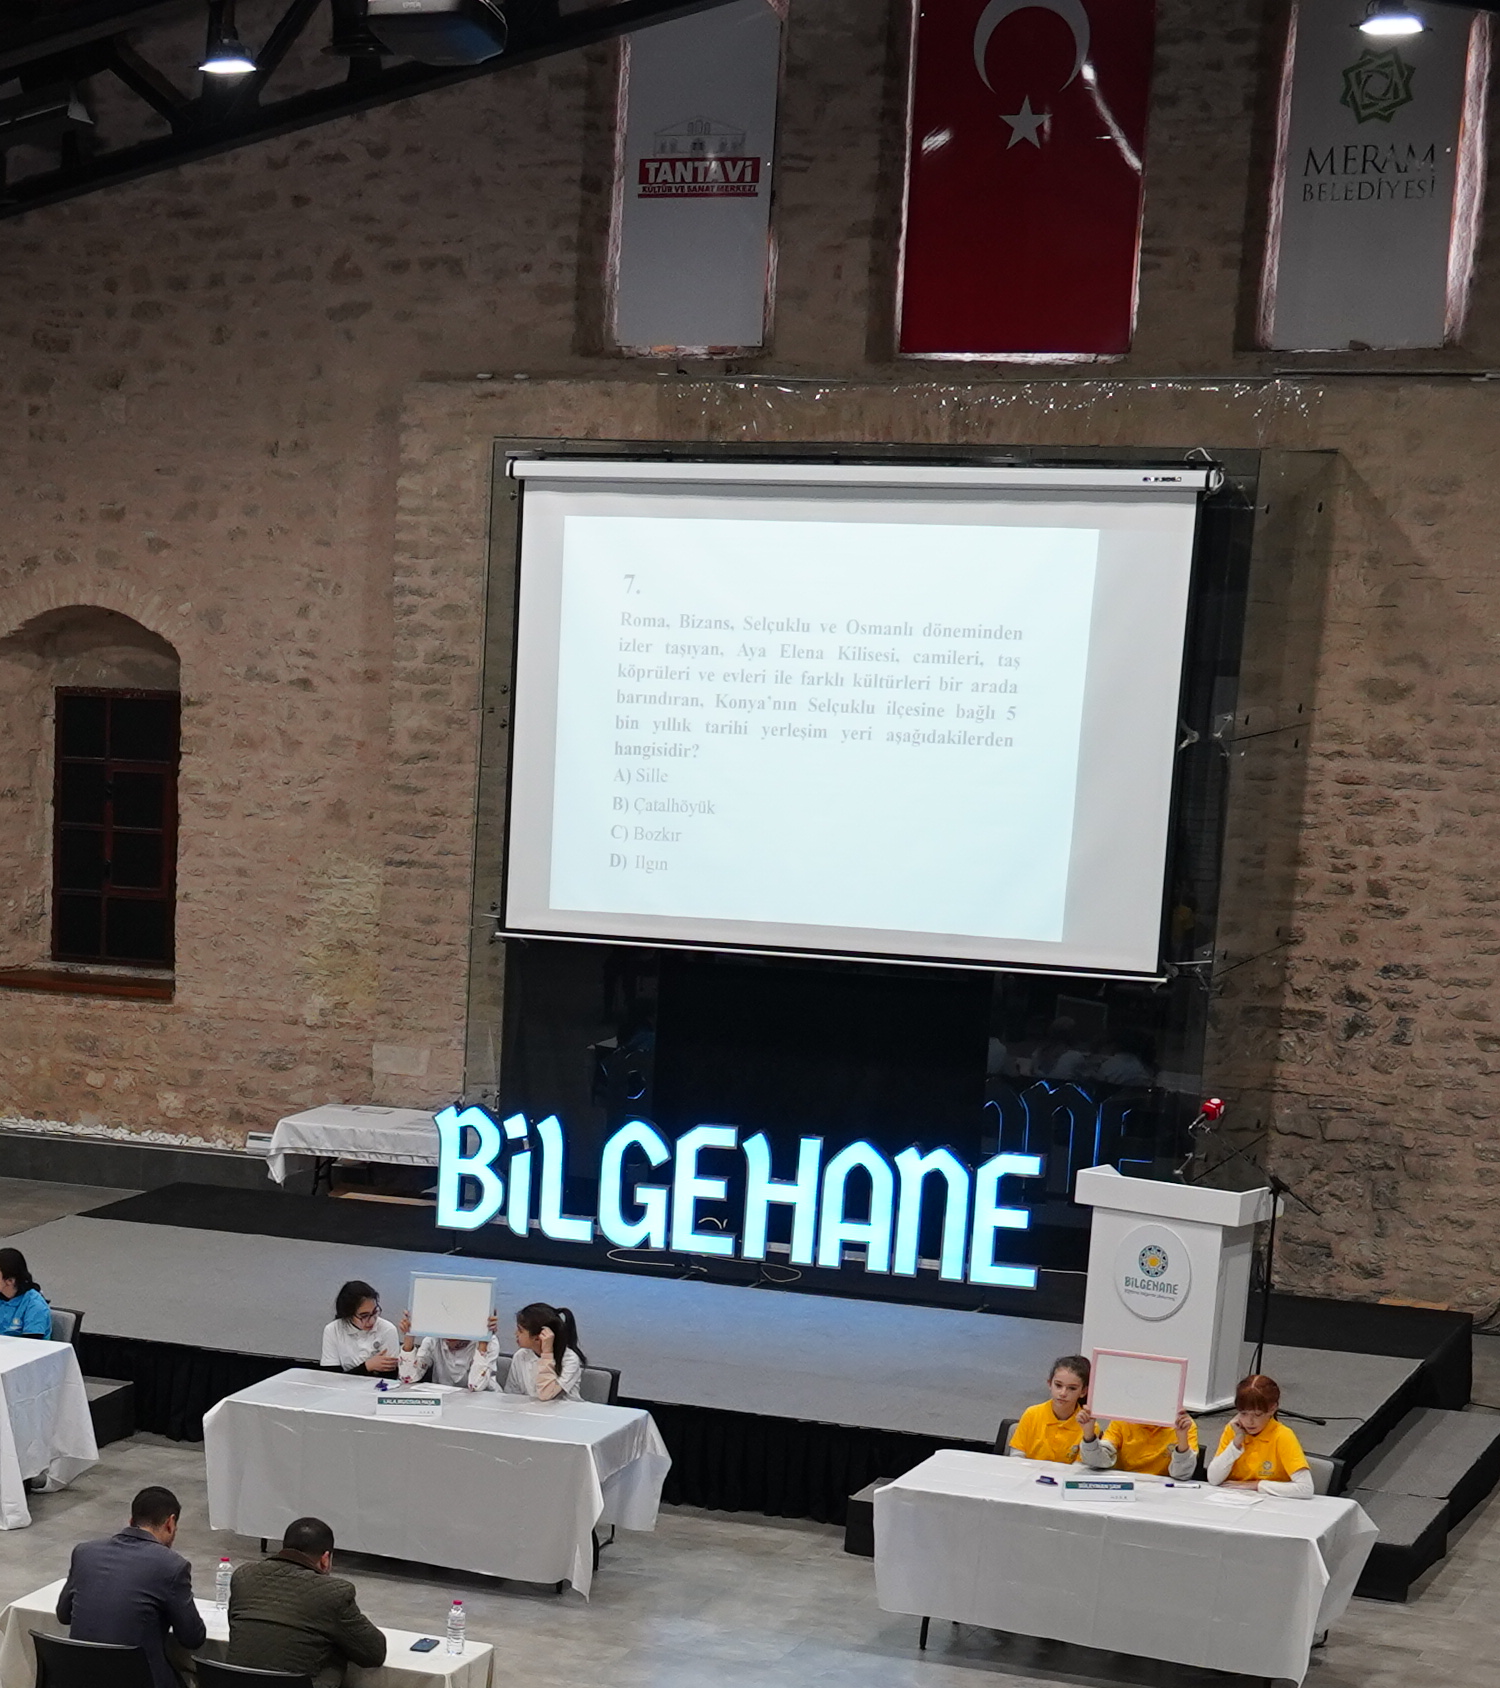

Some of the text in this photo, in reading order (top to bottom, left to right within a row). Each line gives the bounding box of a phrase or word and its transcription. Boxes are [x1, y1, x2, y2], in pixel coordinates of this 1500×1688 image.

[1303, 143, 1436, 177] MERAM
[674, 184, 686, 193] VE
[687, 184, 714, 193] SANAT
[623, 574, 641, 595] 7.
[620, 611, 1023, 641] Roma, Bizans, Selçuklu ve Osmanlı döneminden
[618, 637, 1021, 670] izler taşıyan, Aya Elena Kilisesi, camileri, taş
[617, 663, 1018, 694] köprüleri ve evleri ile farklı kültürleri bir arada
[616, 689, 704, 708] barındıran,
[808, 697, 875, 716] Selçuklu
[886, 700, 945, 719] ilçesine
[956, 704, 995, 724] bağlı
[1006, 706, 1017, 721] 5
[615, 715, 1014, 748] bin yıllık tarihi yerleşim yeri aşağıdakilerden
[614, 741, 700, 760] hangisidir?
[613, 768, 668, 785] A) Sille
[612, 796, 715, 817] B) Çatalhöyük
[610, 824, 682, 843] C) Bozkır
[609, 853, 627, 871] D)
